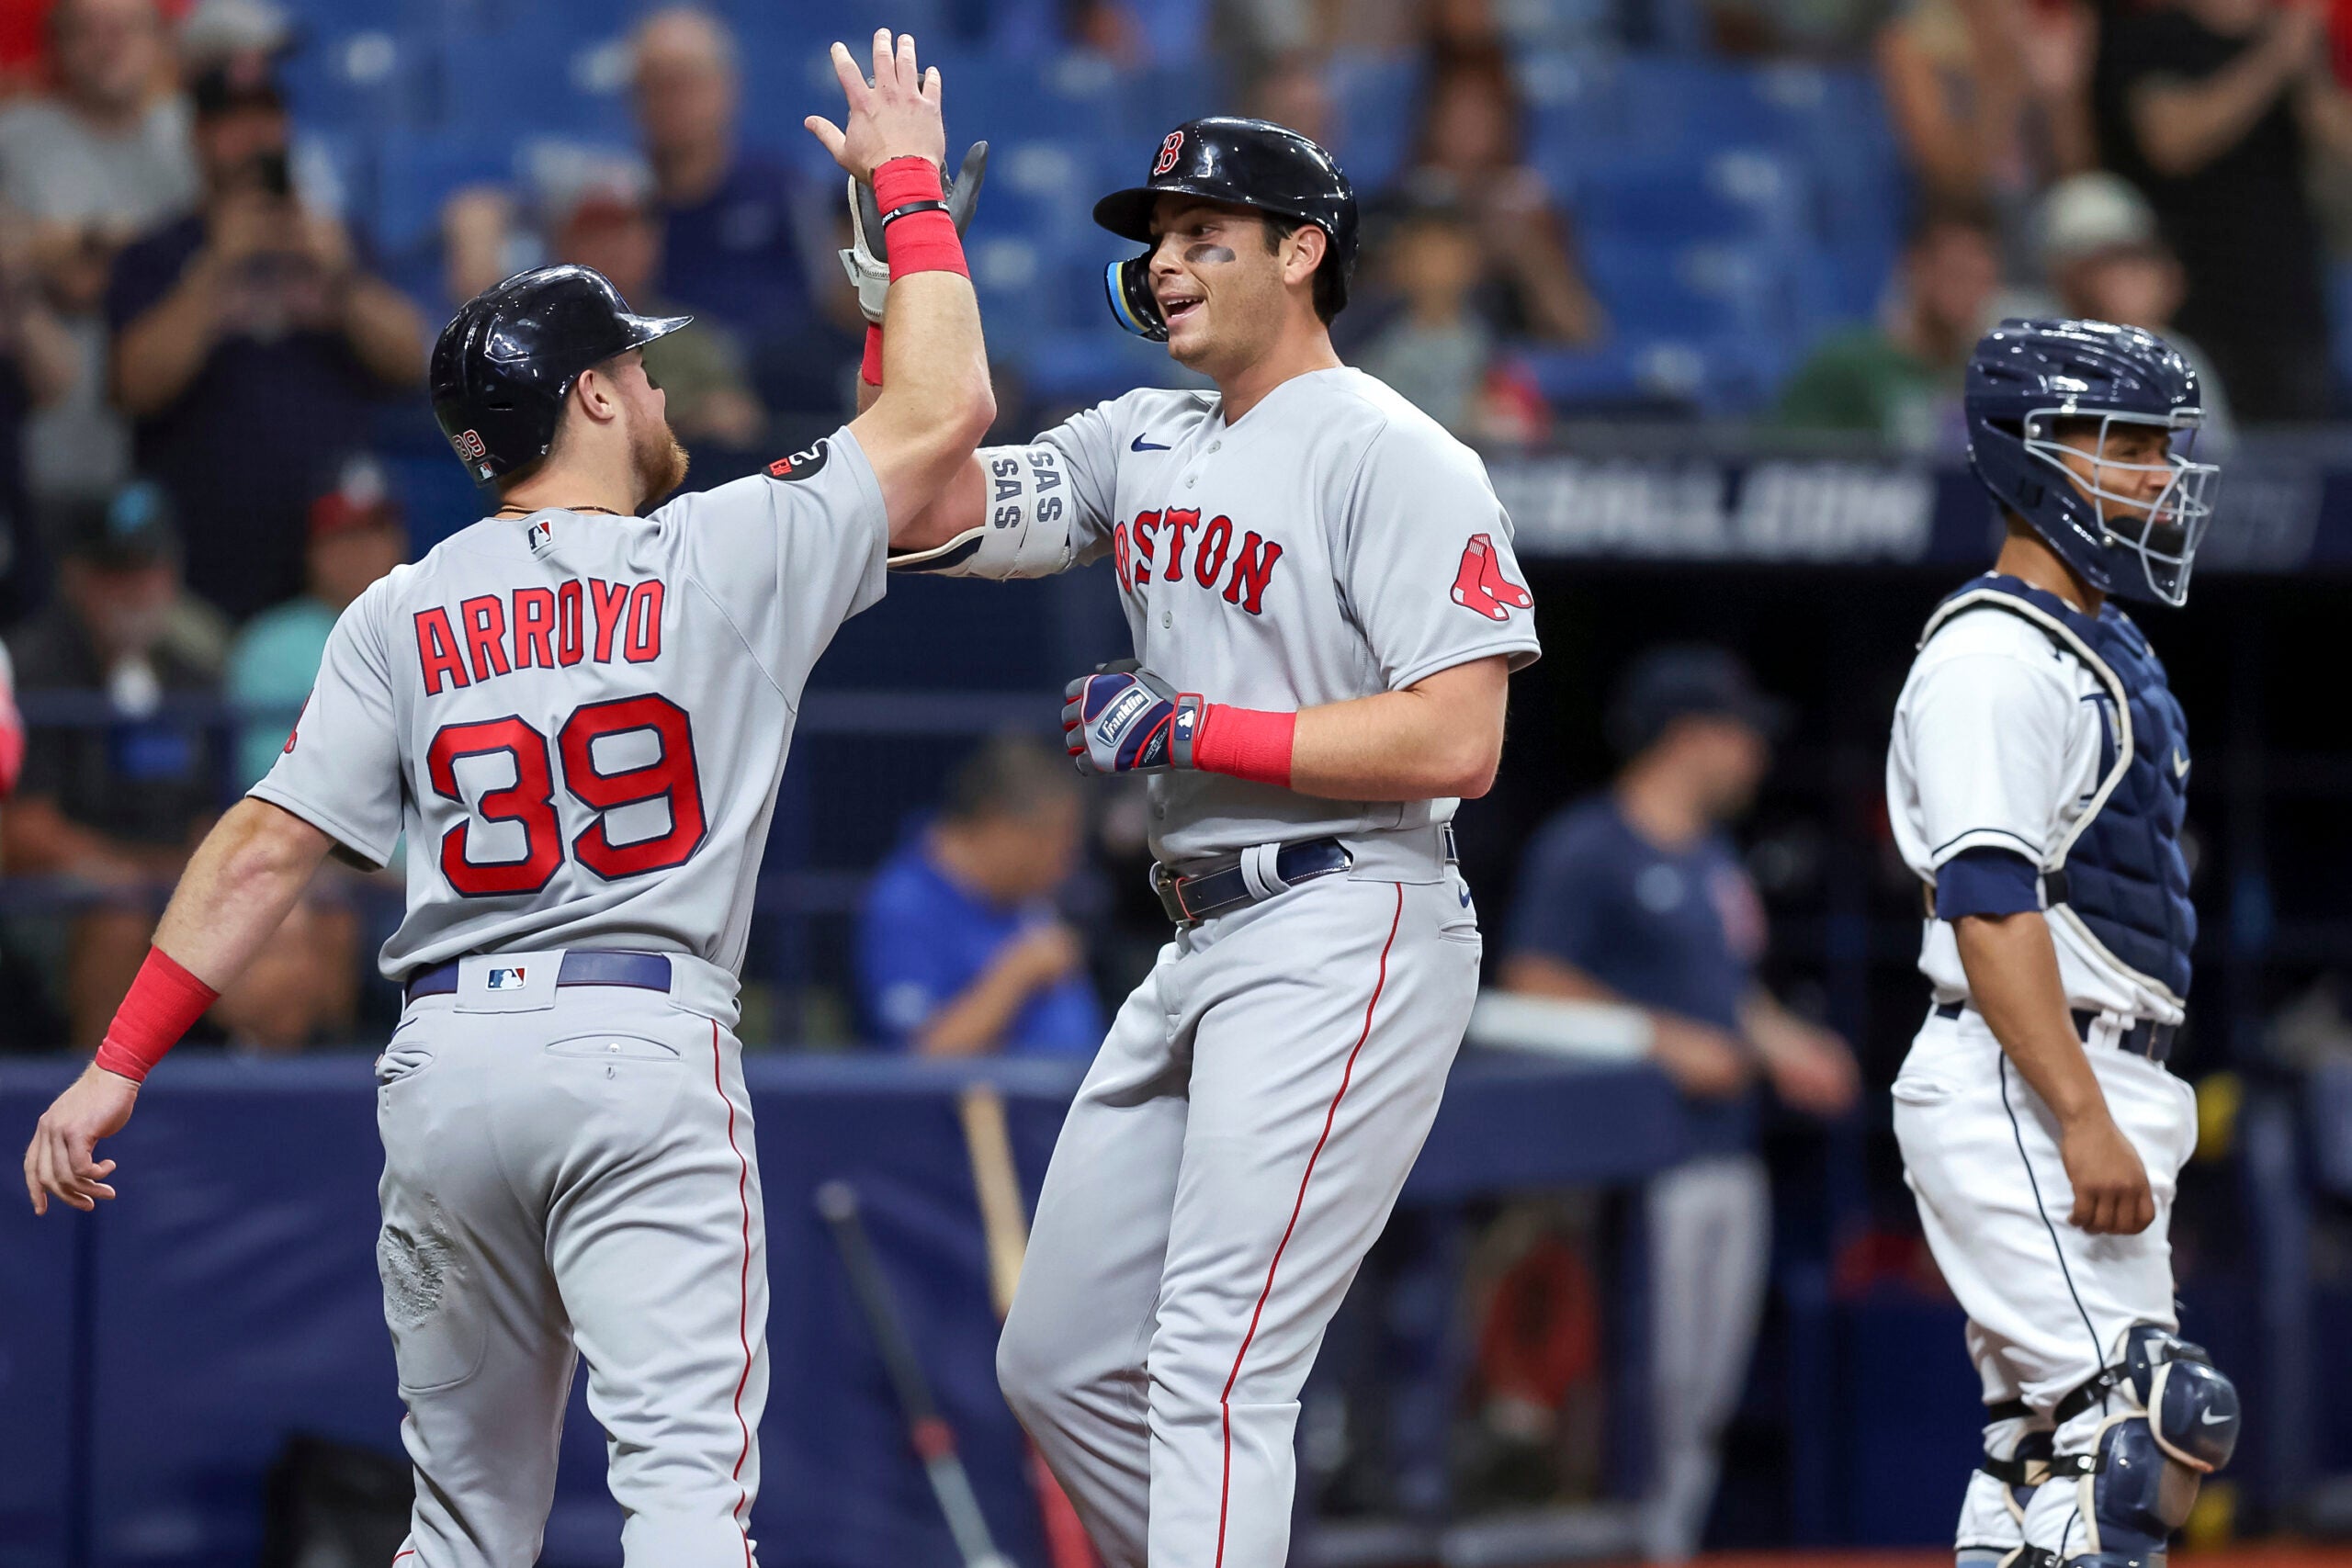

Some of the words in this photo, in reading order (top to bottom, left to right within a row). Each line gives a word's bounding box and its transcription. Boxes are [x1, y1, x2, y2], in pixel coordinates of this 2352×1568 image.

[1153, 130, 1184, 176] B
[1114, 505, 1283, 615] OSTON
[413, 577, 666, 697] ARROYO
[1102, 693, 1146, 743] Franklin
[425, 692, 708, 898] 39
